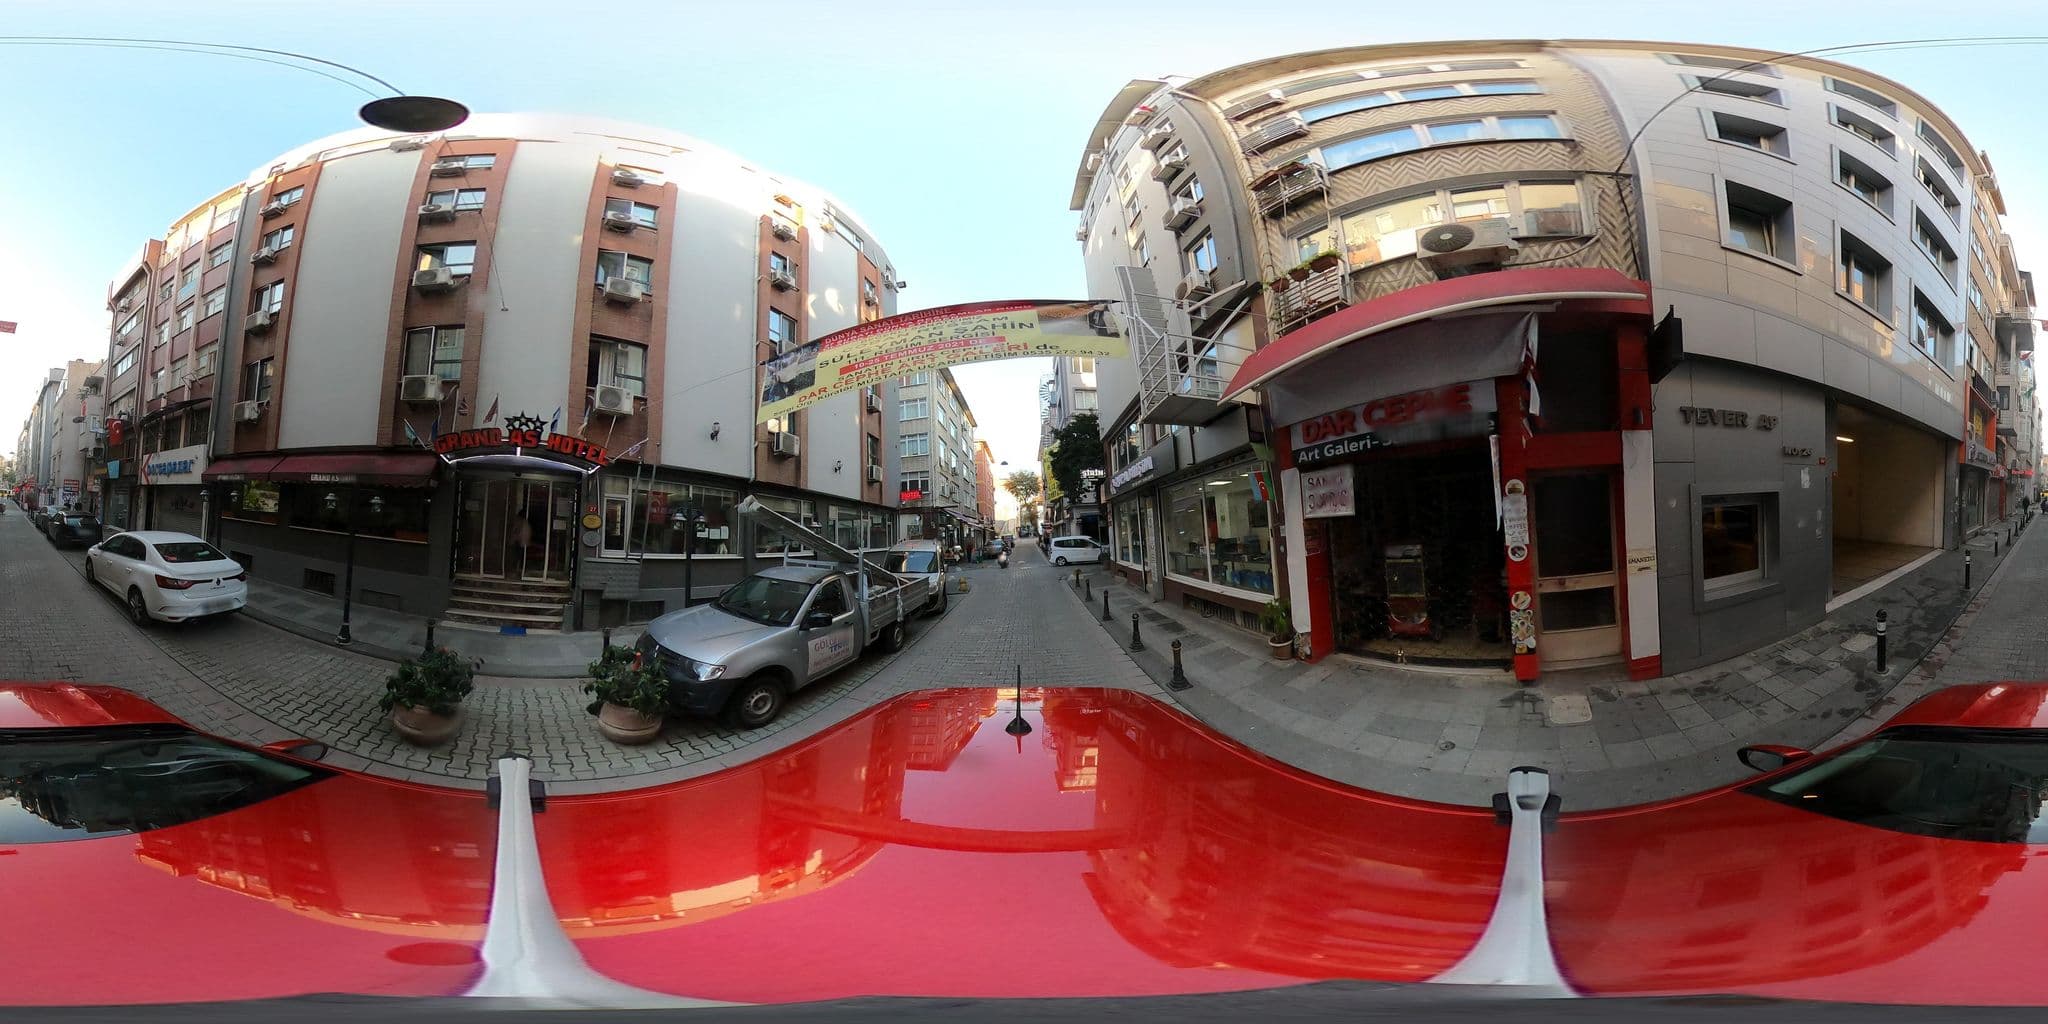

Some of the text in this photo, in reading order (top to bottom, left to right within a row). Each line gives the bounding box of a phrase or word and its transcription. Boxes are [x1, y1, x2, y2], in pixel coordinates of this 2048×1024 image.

[884, 344, 933, 361] TEMMUZ
[938, 340, 964, 349] 2021
[798, 386, 827, 402] DAR
[833, 366, 890, 389] CEPHE
[1303, 411, 1357, 444] DAR
[1679, 406, 1748, 428] TEVER
[434, 428, 609, 465] GRAND AS HOTEL
[1299, 450, 1320, 463] Art
